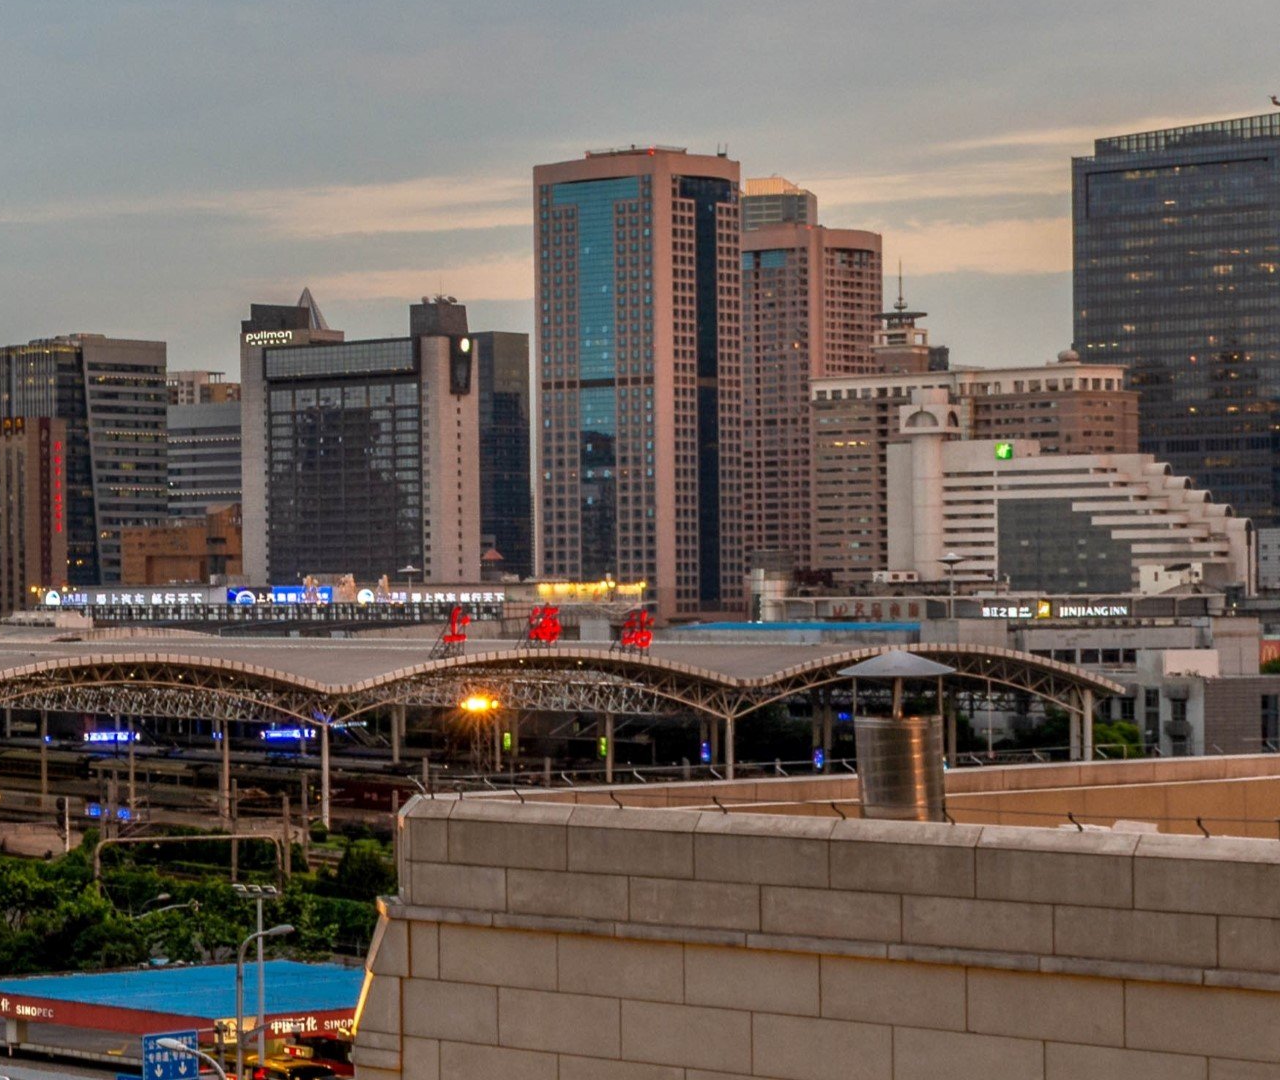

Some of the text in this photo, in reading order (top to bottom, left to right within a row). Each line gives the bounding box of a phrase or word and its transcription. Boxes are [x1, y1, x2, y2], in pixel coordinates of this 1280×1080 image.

[245, 330, 293, 343] pullman
[1059, 606, 1128, 617] JINJIANG INN
[15, 1004, 55, 1019] SINOPEC
